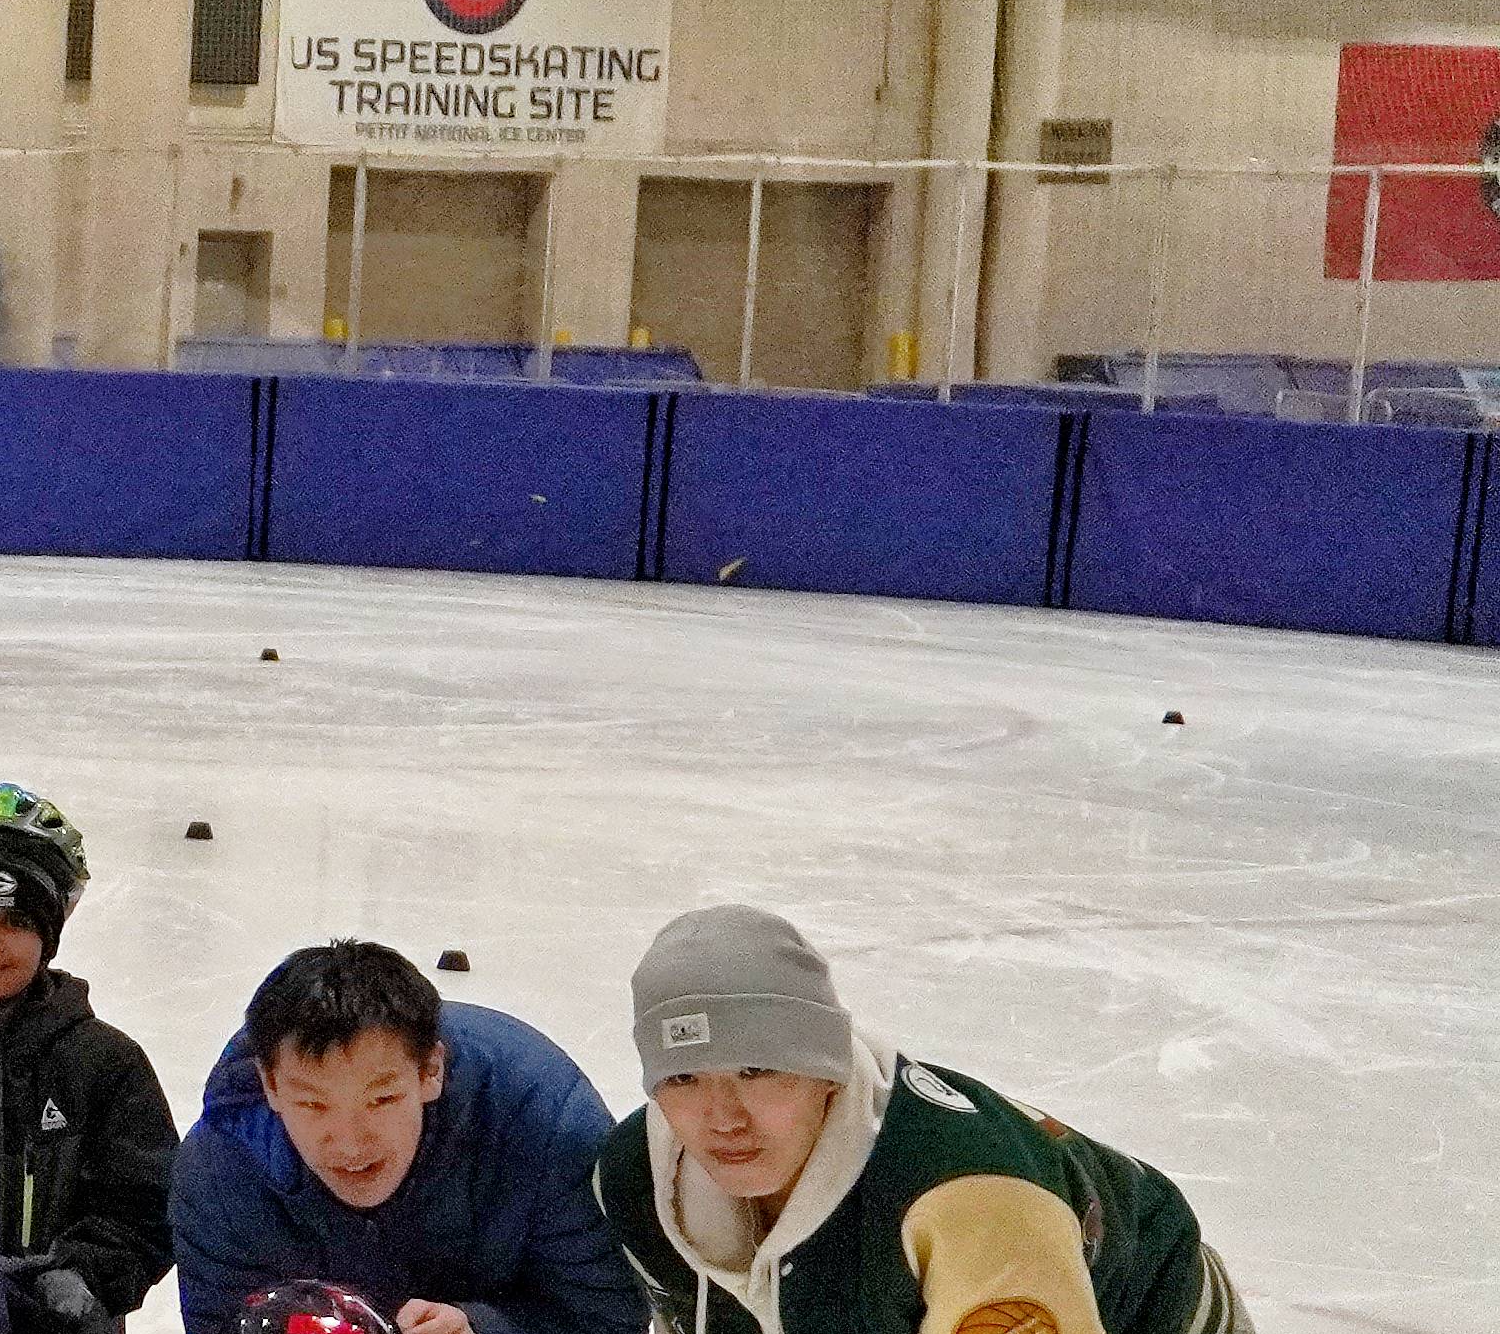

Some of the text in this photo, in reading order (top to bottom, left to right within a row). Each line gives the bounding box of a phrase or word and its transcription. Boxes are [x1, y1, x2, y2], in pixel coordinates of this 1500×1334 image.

[291, 36, 660, 82] US SPEEDSKATING
[330, 79, 617, 122] TRAINING SITE
